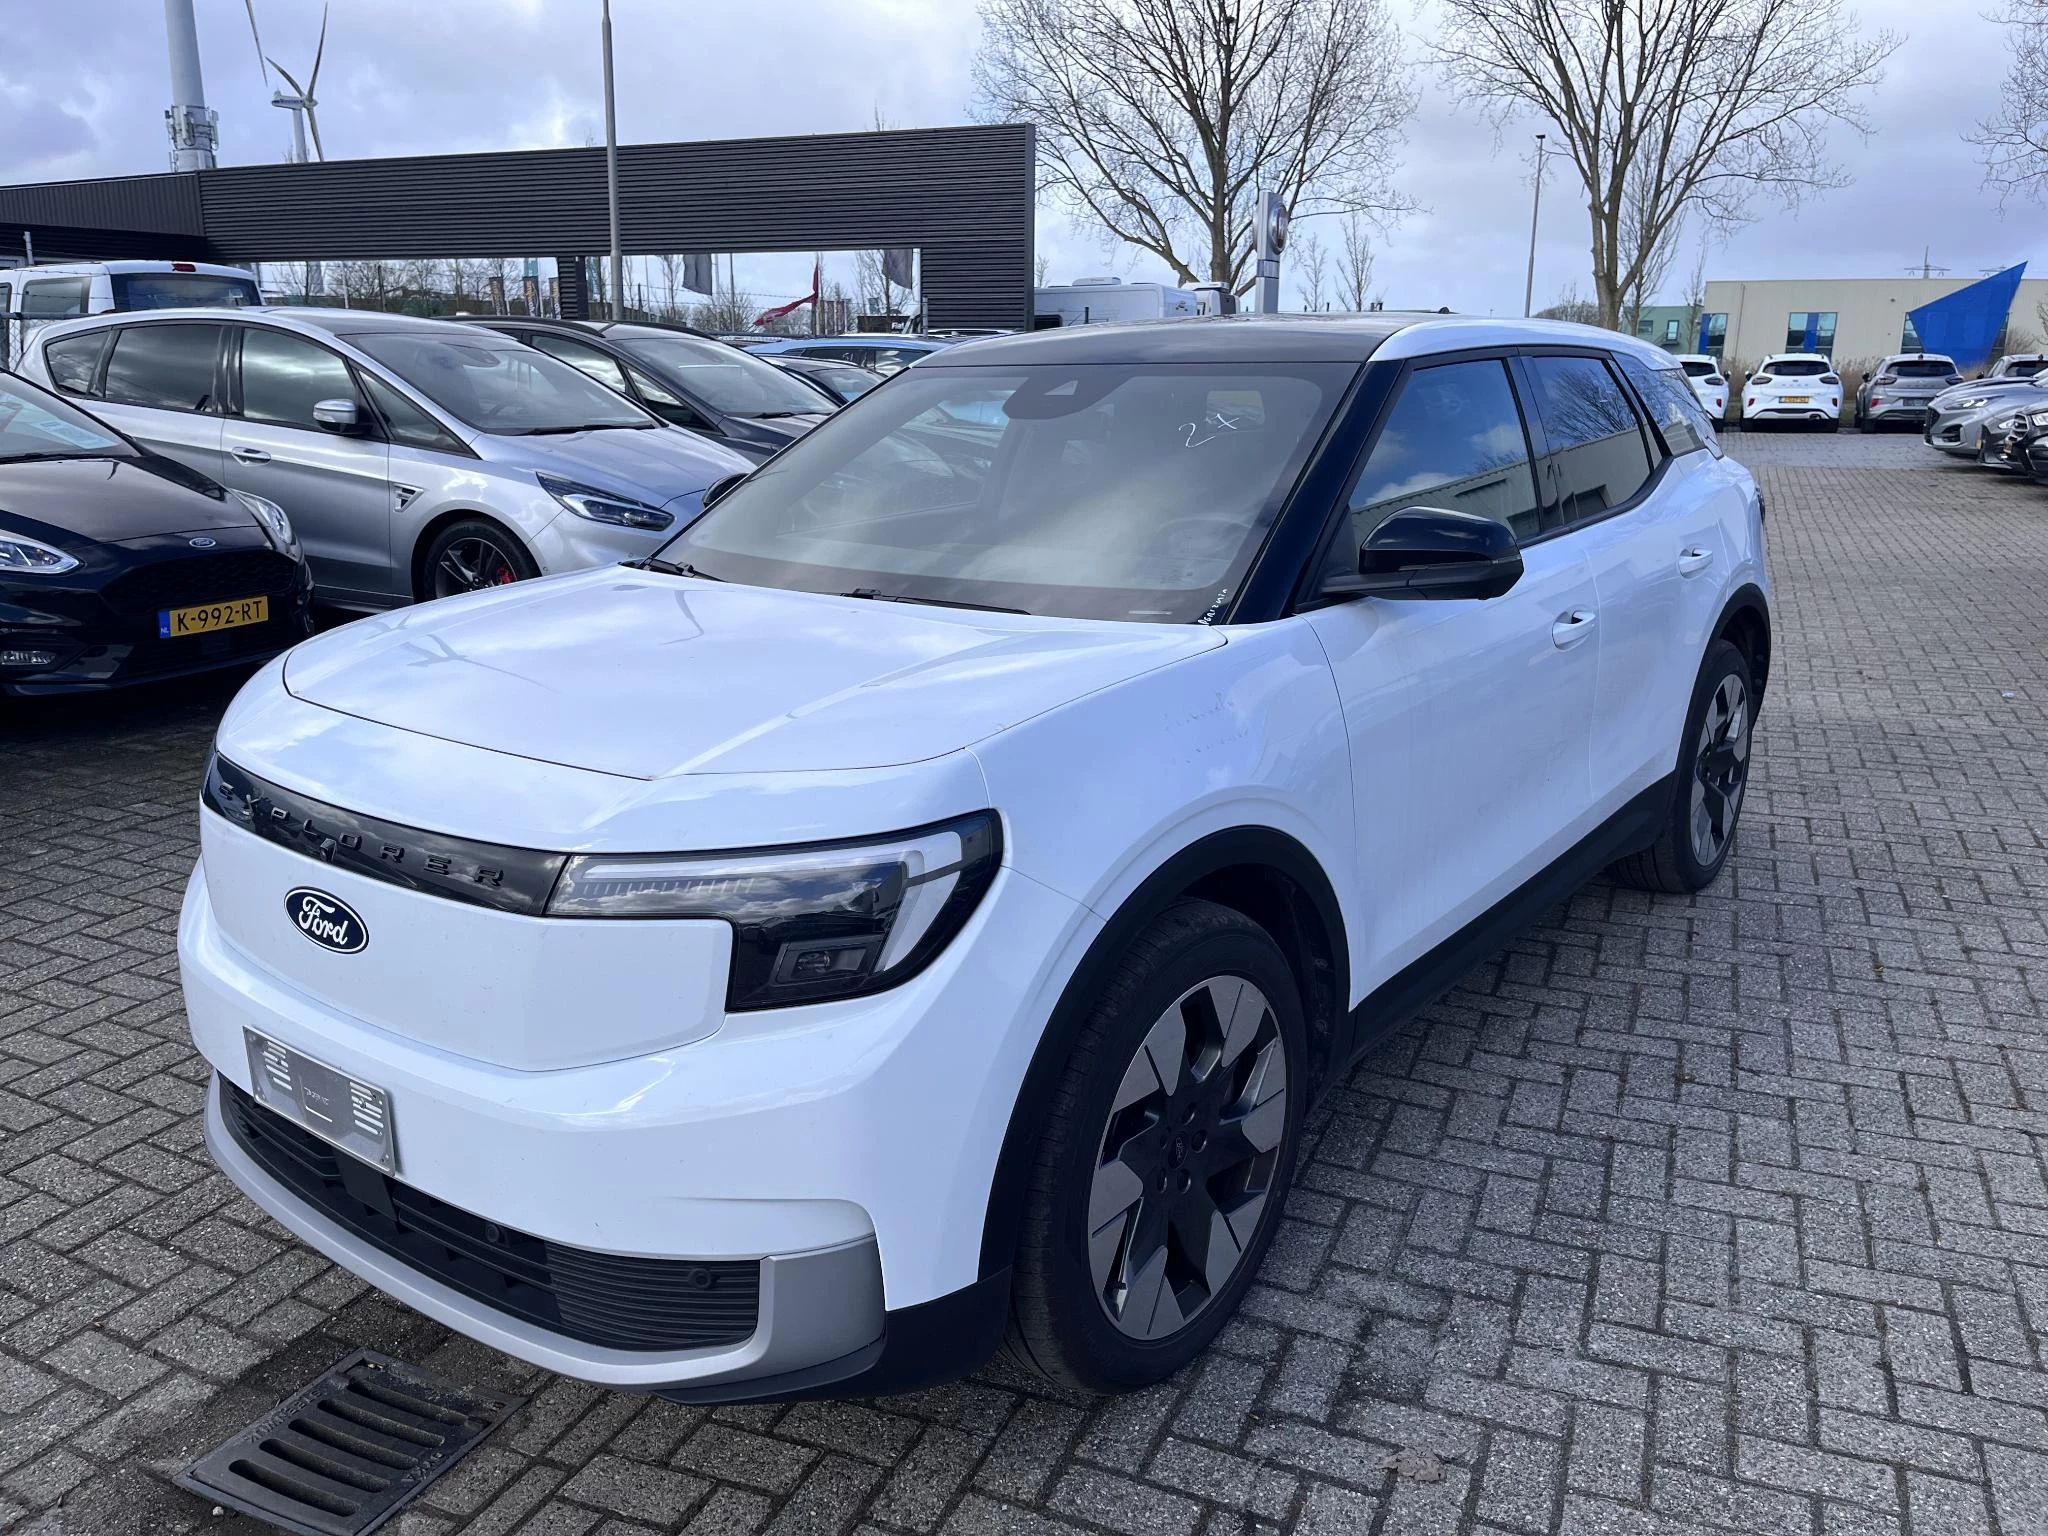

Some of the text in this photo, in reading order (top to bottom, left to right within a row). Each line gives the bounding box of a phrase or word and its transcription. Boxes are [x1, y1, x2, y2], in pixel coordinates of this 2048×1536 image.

[177, 600, 262, 632] K-992-RT
[219, 782, 504, 886] EXPLORER
[298, 896, 349, 946] Ford
